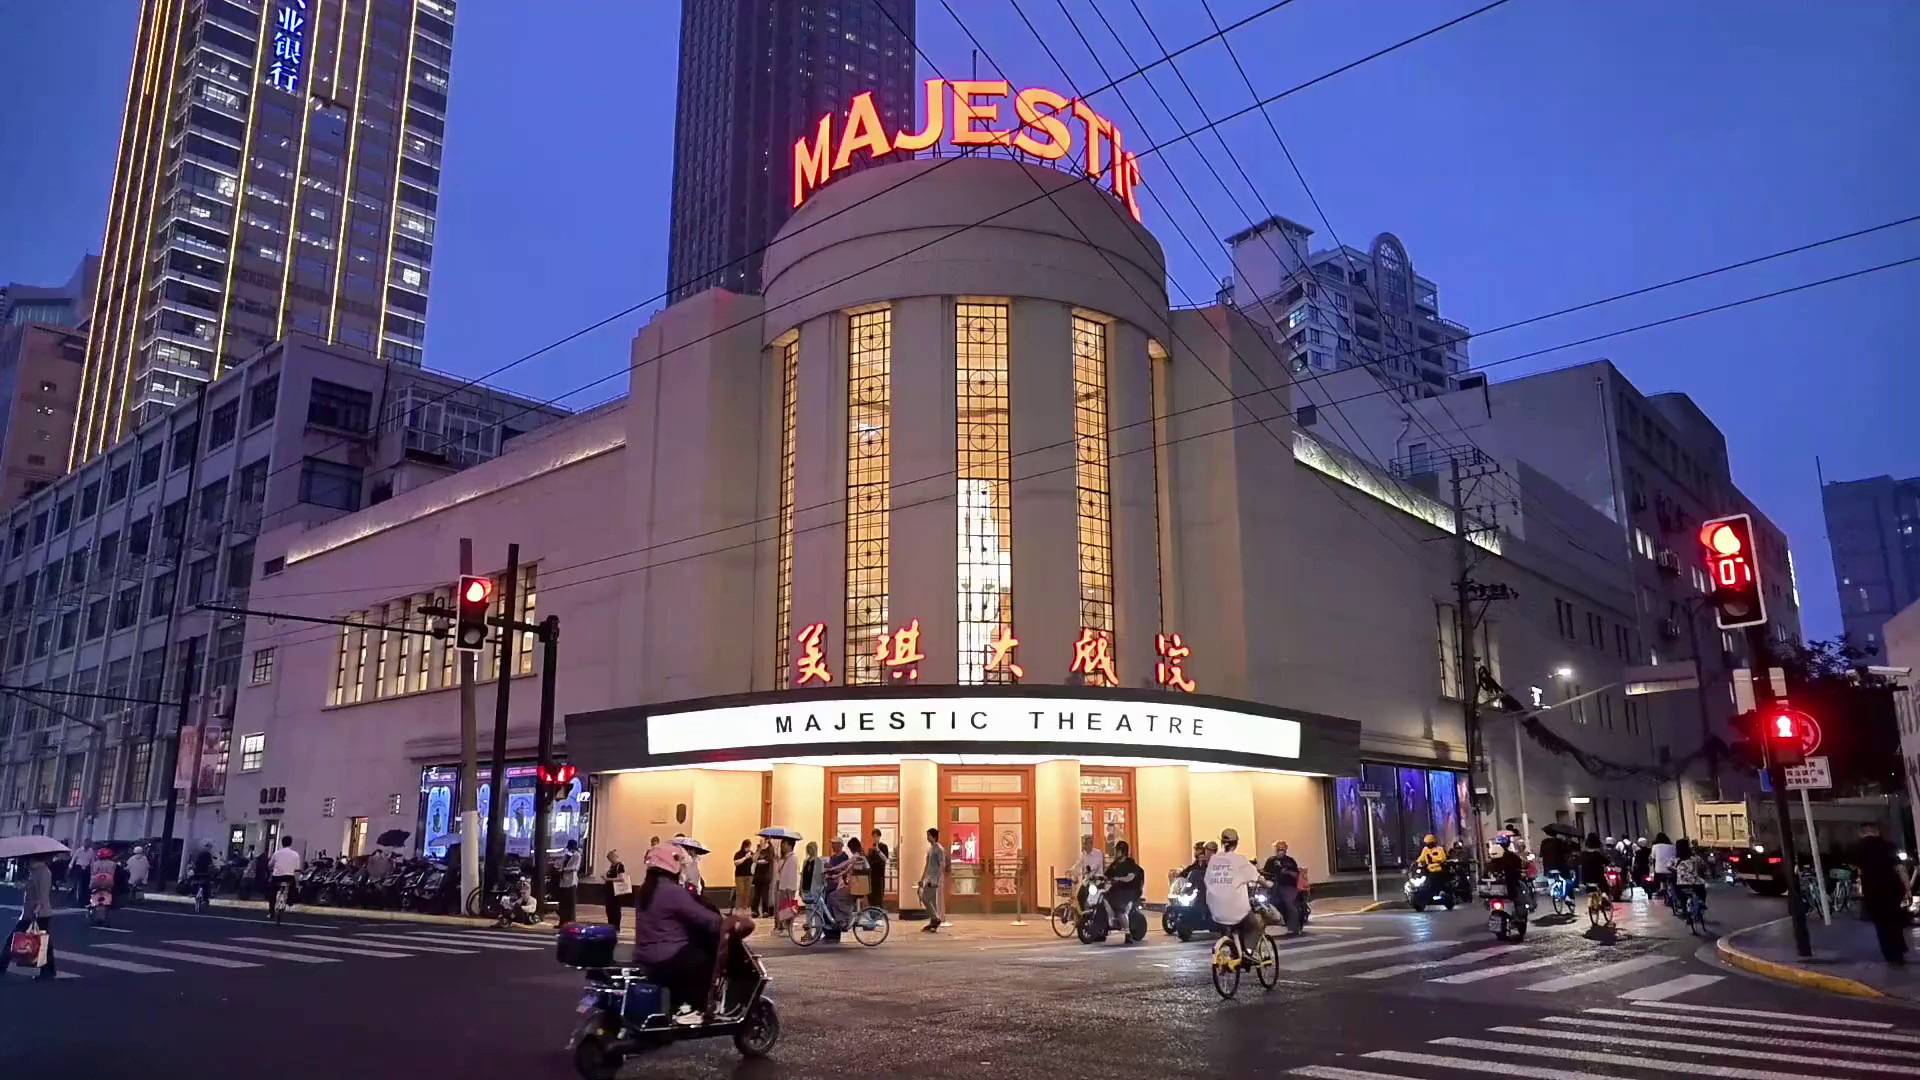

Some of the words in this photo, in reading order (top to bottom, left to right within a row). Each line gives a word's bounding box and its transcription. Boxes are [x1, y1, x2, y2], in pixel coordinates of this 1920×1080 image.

[271, 0, 305, 92] 业银行
[794, 79, 1141, 222] MAJESTIC
[776, 711, 989, 734] MAJESTIC
[1028, 712, 1205, 736] THEATRE
